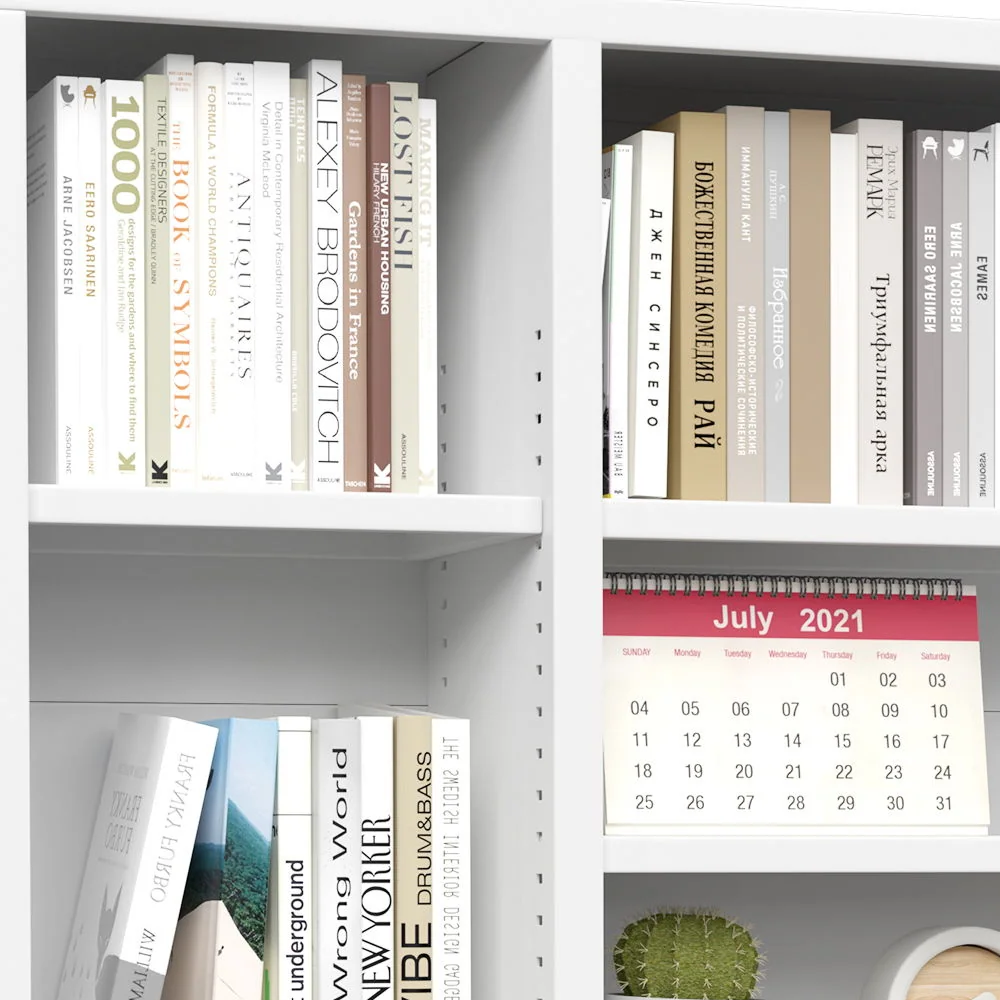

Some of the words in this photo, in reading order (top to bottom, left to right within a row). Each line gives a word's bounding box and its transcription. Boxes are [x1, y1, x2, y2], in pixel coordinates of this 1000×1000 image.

[157, 99, 167, 148] TEXTILE
[207, 85, 217, 150] FORMULA
[316, 71, 339, 214] ALEXEY
[393, 95, 413, 184] LOST
[111, 95, 141, 214] 1000
[381, 163, 389, 195] NEW
[740, 146, 751, 210] ИММАНУИЛ
[866, 144, 884, 220] РЕМАРК
[63, 176, 73, 214] ARNE
[85, 182, 95, 218] EERO
[158, 152, 168, 224] DESIGNERS
[172, 160, 190, 243] BOOK
[207, 165, 217, 214] WORLD
[127, 219, 136, 256] designs
[348, 201, 362, 283] Gardens
[381, 199, 389, 247] URBAN
[394, 195, 413, 269] FISH
[649, 208, 663, 280] ДЖЕН
[694, 161, 714, 296] БОЖЕСТВЕННАЯ
[741, 213, 752, 243] КАНТ
[63, 220, 73, 295] JACOBSEN
[86, 225, 96, 297] SAARINEN
[128, 257, 137, 272] for
[208, 218, 217, 297] CHAMPIONS
[234, 172, 252, 381] ANTIQUAIRES
[380, 251, 390, 315] HOUSING
[127, 291, 136, 330] gardens
[349, 287, 362, 307] in
[768, 267, 789, 369] Избранное
[128, 332, 136, 350] and
[128, 352, 137, 382] where
[173, 279, 191, 430] SYMBOLS
[317, 227, 340, 464] BRODOVITCH
[348, 314, 362, 380] France
[647, 303, 661, 427] СИНСЕРО
[693, 301, 714, 383] КОМЕДИЯ
[870, 273, 891, 421] Триумфальная
[129, 385, 136, 394] to
[129, 397, 137, 416] find
[694, 399, 722, 449] РАЙ
[870, 429, 887, 473] арка
[713, 604, 774, 635] July
[799, 608, 864, 633] 2021
[622, 647, 651, 657] SUNDAY
[674, 648, 702, 658] Monday
[724, 649, 752, 659] Tuesday
[768, 650, 808, 660] Wednesday
[822, 650, 853, 661] Thursday
[876, 651, 898, 662] Friday
[921, 651, 951, 662] Saturday
[831, 672, 845, 686] 01
[880, 673, 896, 687] 02
[929, 673, 946, 687] 03
[631, 701, 648, 715] 04
[682, 701, 699, 715] 05
[732, 702, 749, 716] 06
[782, 703, 799, 716] 07
[832, 703, 849, 717] 08
[882, 704, 898, 717] 09
[932, 704, 947, 717] 10
[634, 733, 647, 746] 11
[684, 733, 700, 746] 12
[735, 733, 751, 747] 13
[785, 734, 801, 747] 14
[835, 734, 850, 747] 15
[884, 735, 900, 748] 16
[933, 735, 949, 748] 17
[635, 764, 652, 777] 18
[686, 764, 702, 778] 19
[736, 764, 753, 778] 20
[786, 765, 800, 778] 21
[836, 765, 852, 779] 22
[885, 765, 902, 779] 23
[935, 766, 951, 779] 24
[636, 795, 653, 809] 25
[687, 795, 704, 809] 26
[738, 796, 754, 809] 27
[788, 796, 804, 809] 28
[838, 796, 854, 809] 29
[887, 796, 904, 810] 30
[937, 796, 950, 810] 31
[332, 748, 348, 860] World
[417, 751, 432, 905] DRUM&BASS
[285, 860, 307, 991] underground
